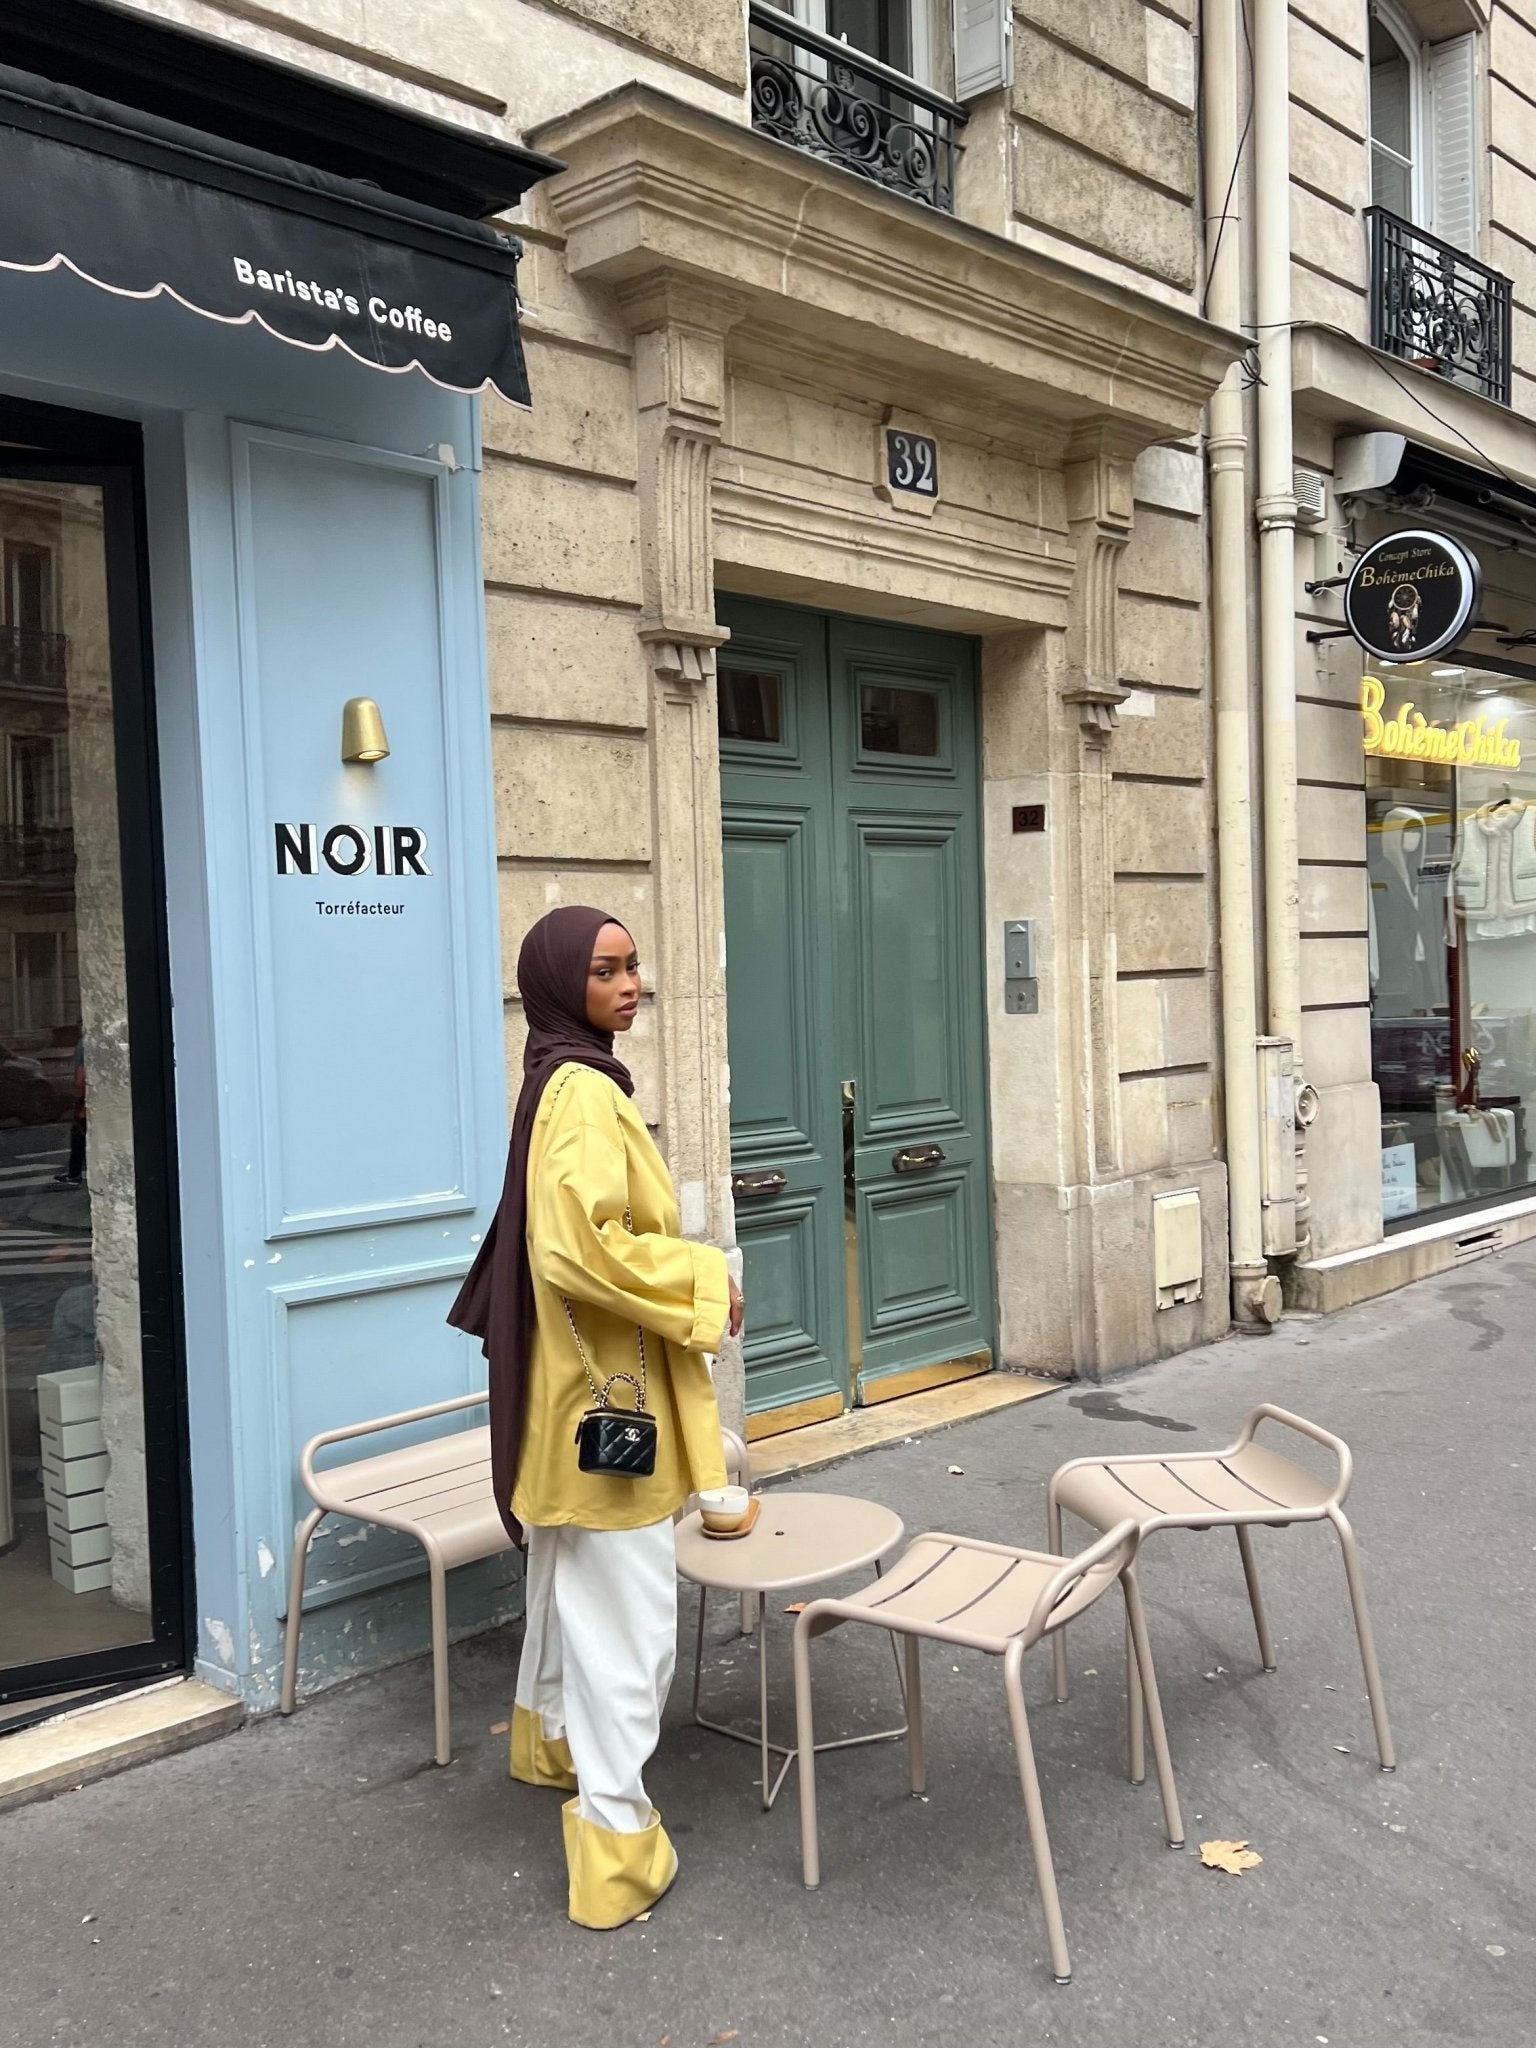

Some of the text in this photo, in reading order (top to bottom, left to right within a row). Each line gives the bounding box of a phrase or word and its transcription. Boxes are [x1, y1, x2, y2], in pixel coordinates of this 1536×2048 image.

[233, 256, 452, 342] Barista’s Coffee
[895, 436, 933, 492] 32
[1411, 547, 1432, 558] Store
[1360, 561, 1454, 587] BohèmeChika
[1018, 810, 1040, 827] 32
[274, 823, 434, 876] NOIR
[315, 900, 405, 915] Torréfacteur
